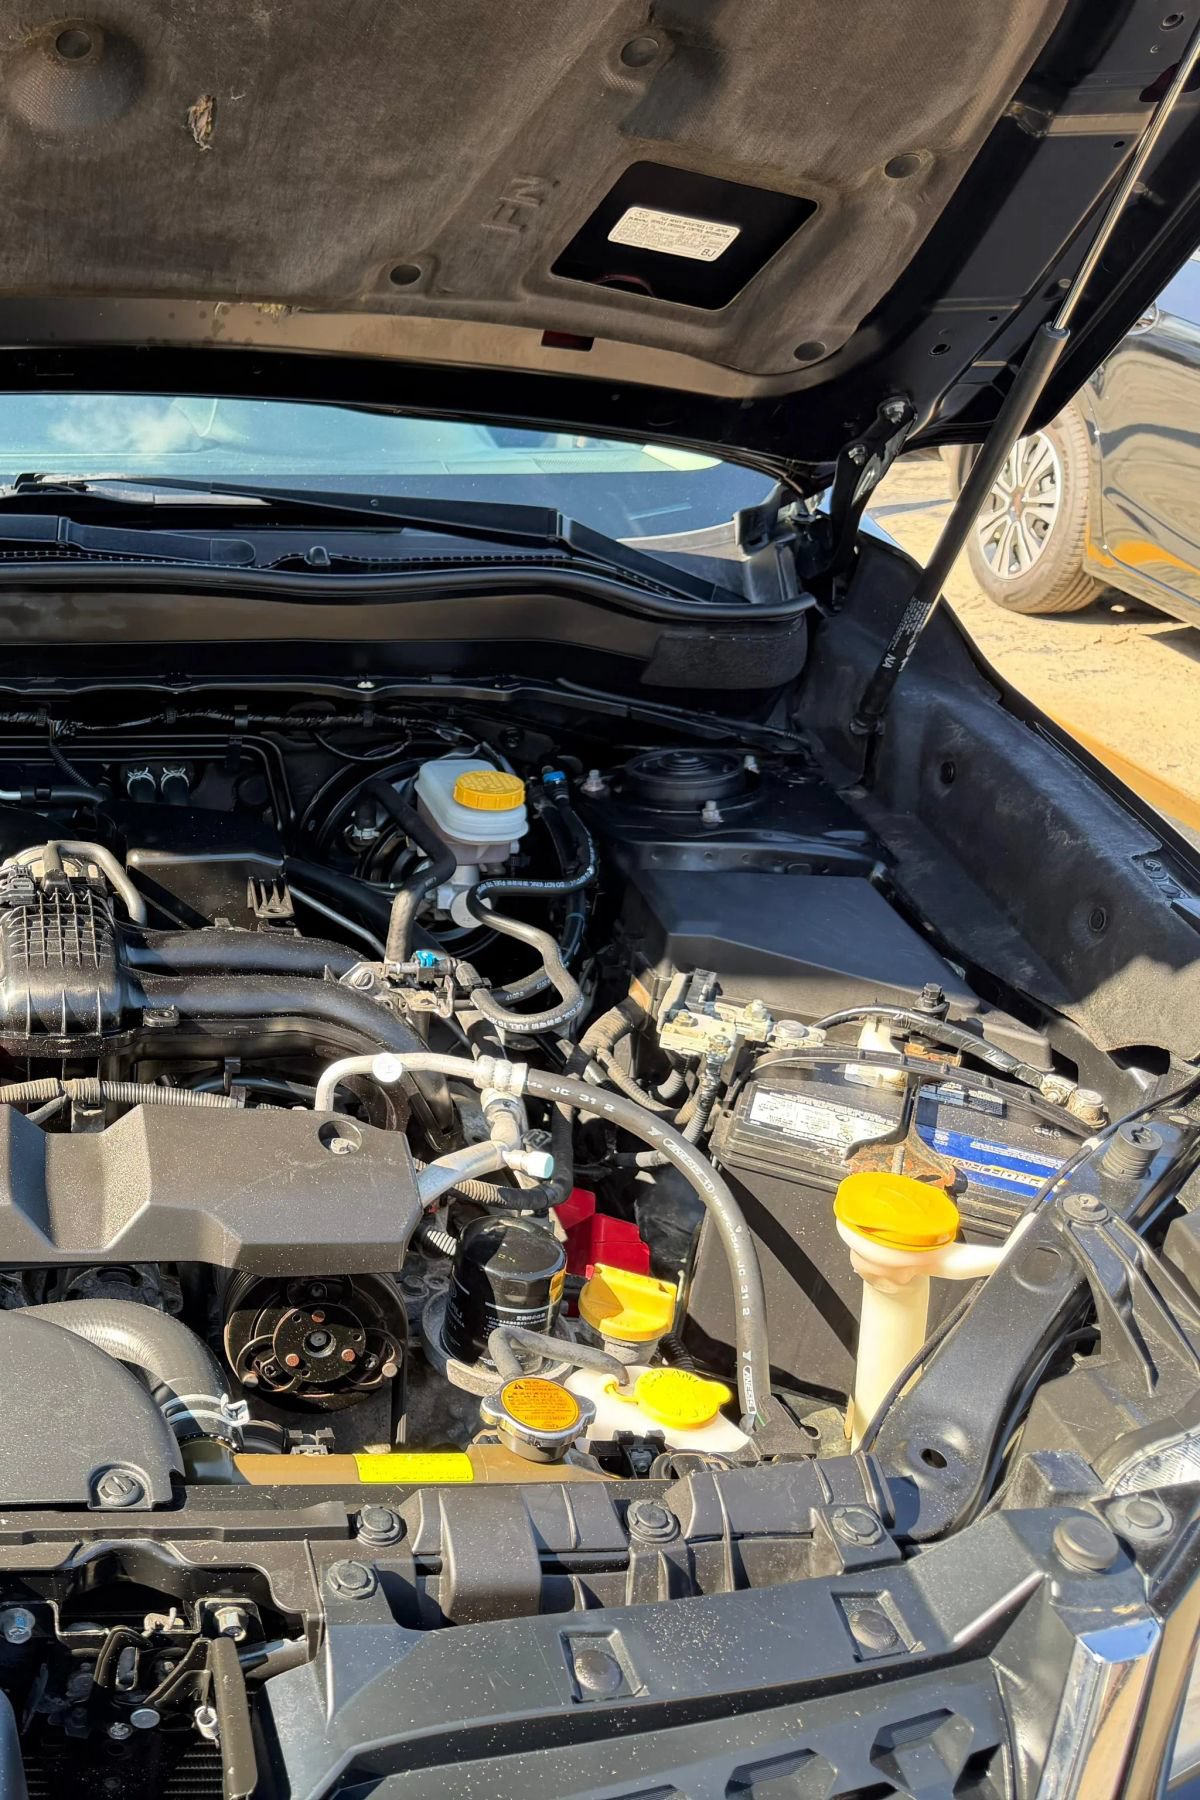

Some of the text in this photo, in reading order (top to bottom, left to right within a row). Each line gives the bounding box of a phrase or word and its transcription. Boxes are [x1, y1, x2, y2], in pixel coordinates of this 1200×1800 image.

[700, 248, 716, 258] BJ
[602, 1103, 615, 1115] 2
[741, 1305, 752, 1317] 2
